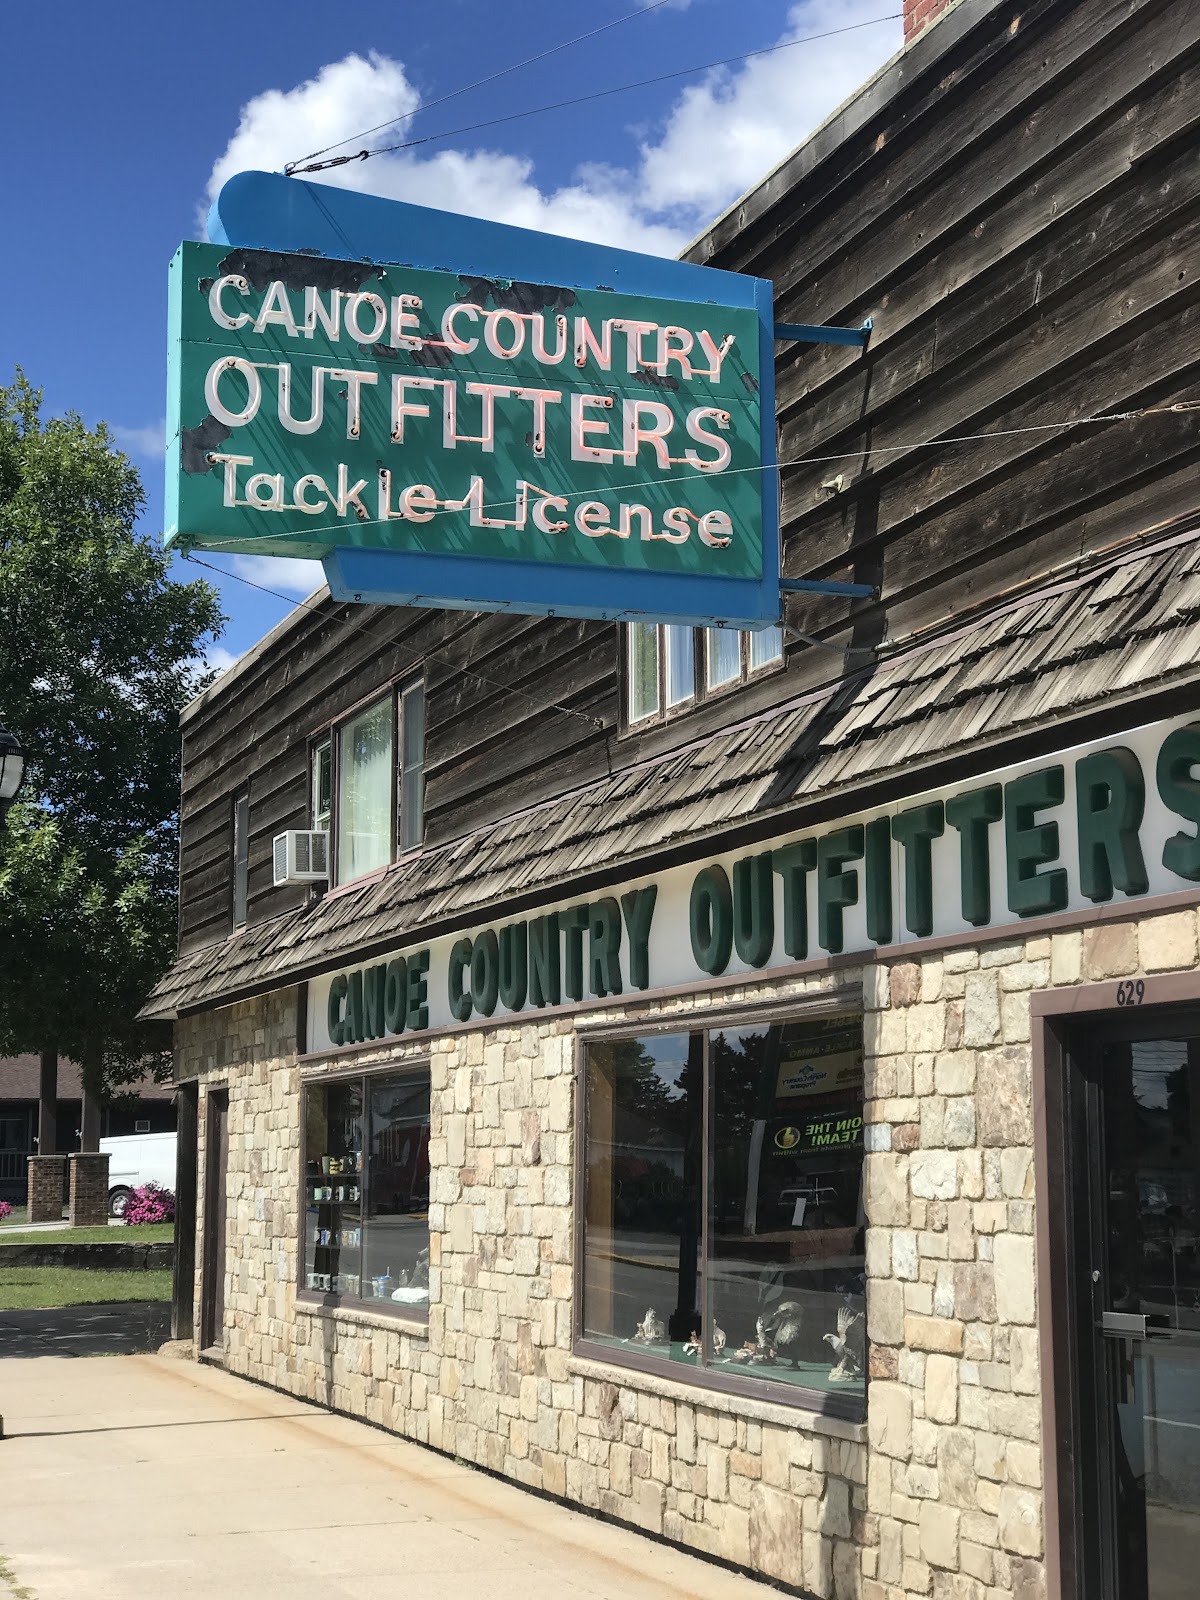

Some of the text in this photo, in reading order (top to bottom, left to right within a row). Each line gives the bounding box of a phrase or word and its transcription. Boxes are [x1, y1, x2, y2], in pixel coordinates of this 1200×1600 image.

[208, 274, 736, 383] CANOE COUNTRY
[203, 355, 733, 474] OUTFITTERS
[328, 720, 1200, 1046] CANOE COUNTRY OUTFITTERS
[1116, 980, 1145, 1007] 629
